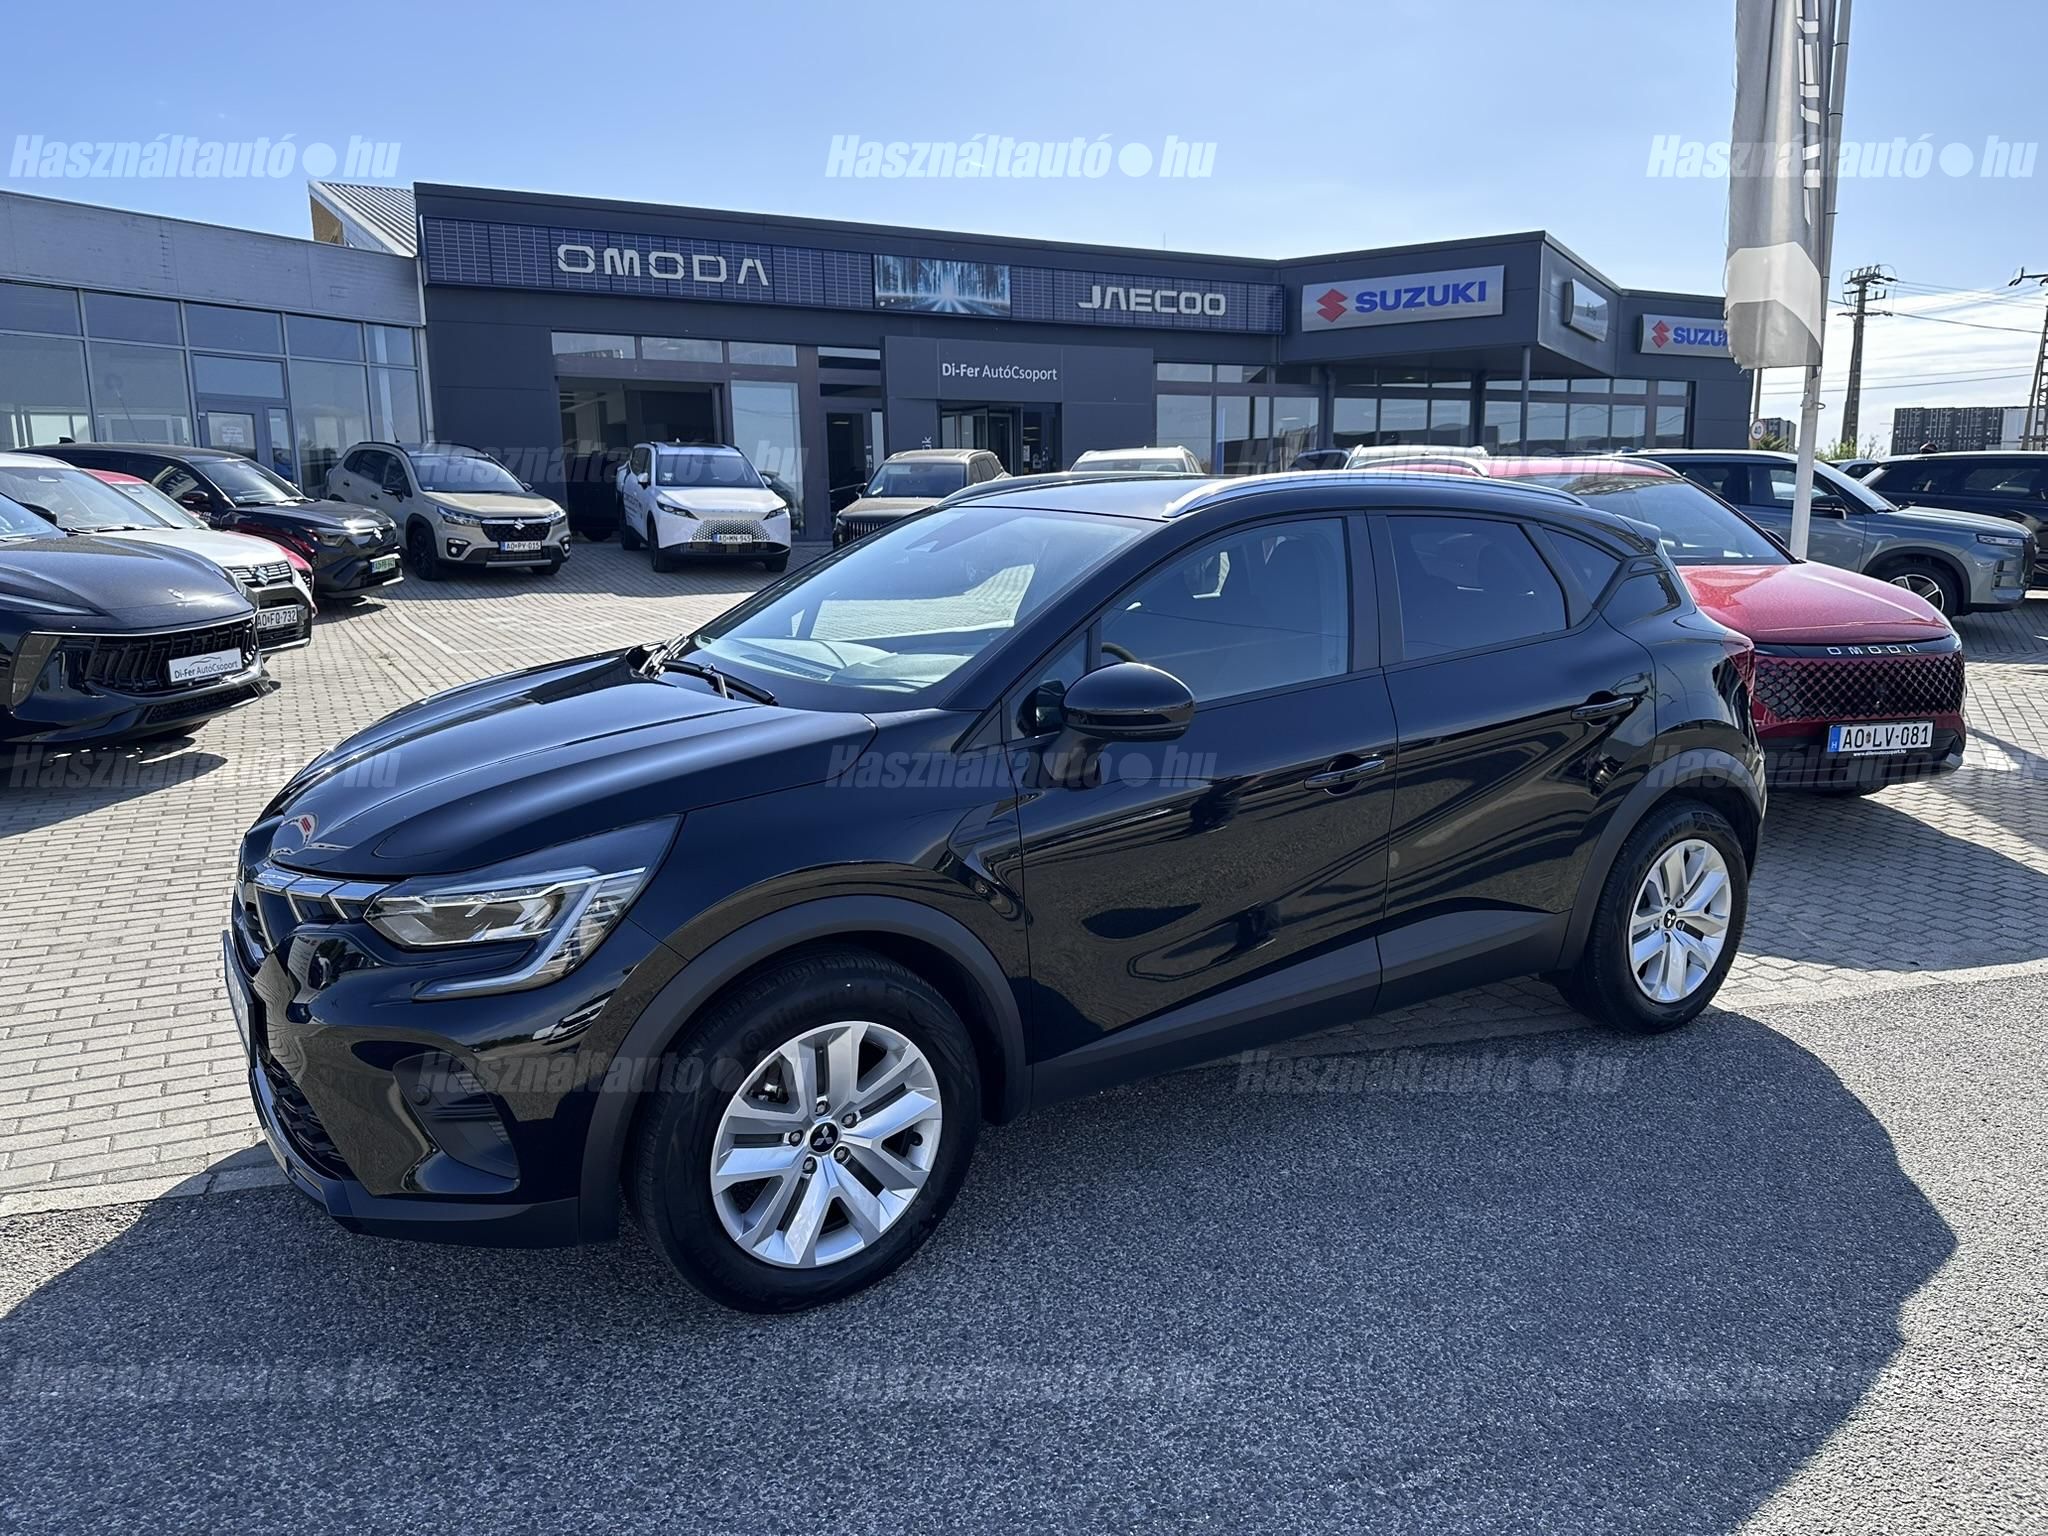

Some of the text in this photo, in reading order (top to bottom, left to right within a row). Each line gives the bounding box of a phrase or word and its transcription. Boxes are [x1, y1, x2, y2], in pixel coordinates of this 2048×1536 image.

[557, 244, 769, 286] OMODA
[1076, 285, 1226, 316] JAECOO
[1354, 280, 1487, 313] SUZUKI
[942, 363, 1058, 382] Di-Fer AutóCsoport
[1826, 644, 1919, 655] OMODA
[174, 668, 195, 679] Di-Fer
